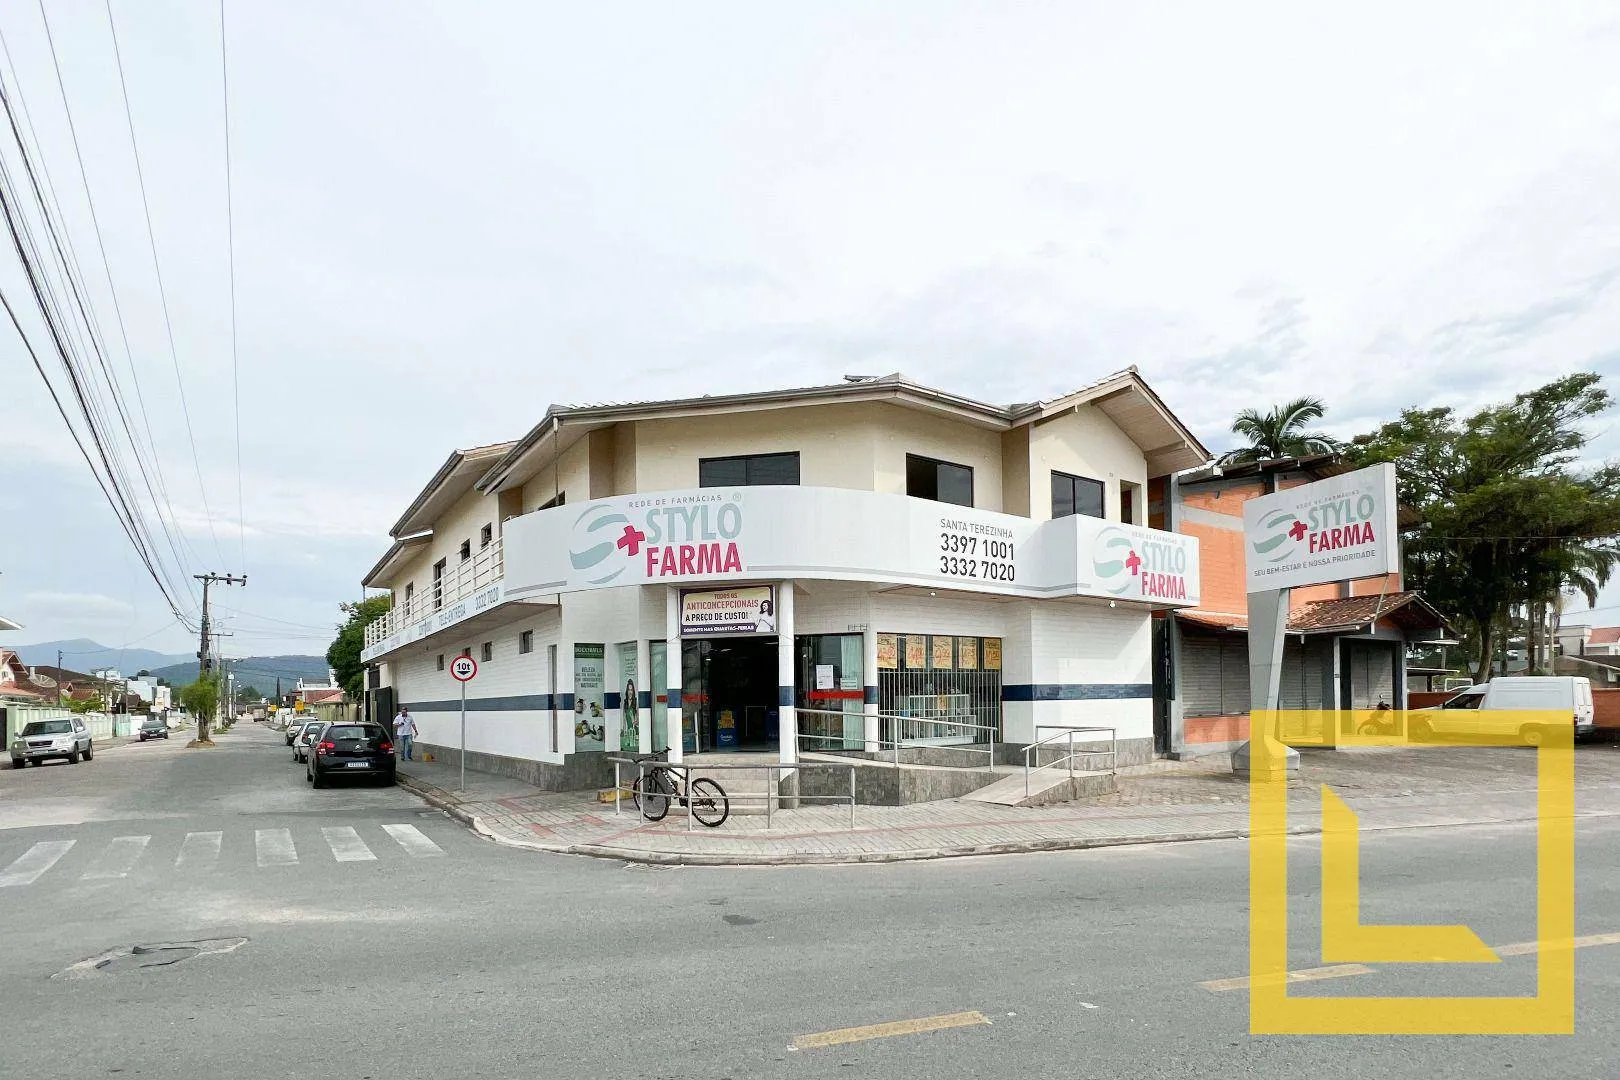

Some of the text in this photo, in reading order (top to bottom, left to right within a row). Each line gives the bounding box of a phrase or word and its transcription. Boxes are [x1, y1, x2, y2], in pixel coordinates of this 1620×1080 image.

[646, 503, 742, 544] STYLO
[1308, 494, 1375, 531] STYLO
[940, 518, 1013, 539] SANTA TEREZINHA
[1309, 521, 1375, 554] FARMA
[647, 542, 742, 577] FARMA
[940, 532, 1014, 560] 3397 1001
[1142, 541, 1186, 573] STYLO
[940, 555, 1015, 581] 3332 7020
[1254, 569, 1266, 577] SEU
[1266, 561, 1302, 575] BEM-ESTAR
[1308, 558, 1331, 568] NOSSA
[1332, 549, 1377, 563] PRIORIDADE
[1141, 571, 1186, 600] FARMA
[685, 613, 691, 621] A
[714, 612, 723, 621] DE
[686, 599, 759, 611] ANTICONCEPCIONAIS
[456, 662, 471, 671] 10t
